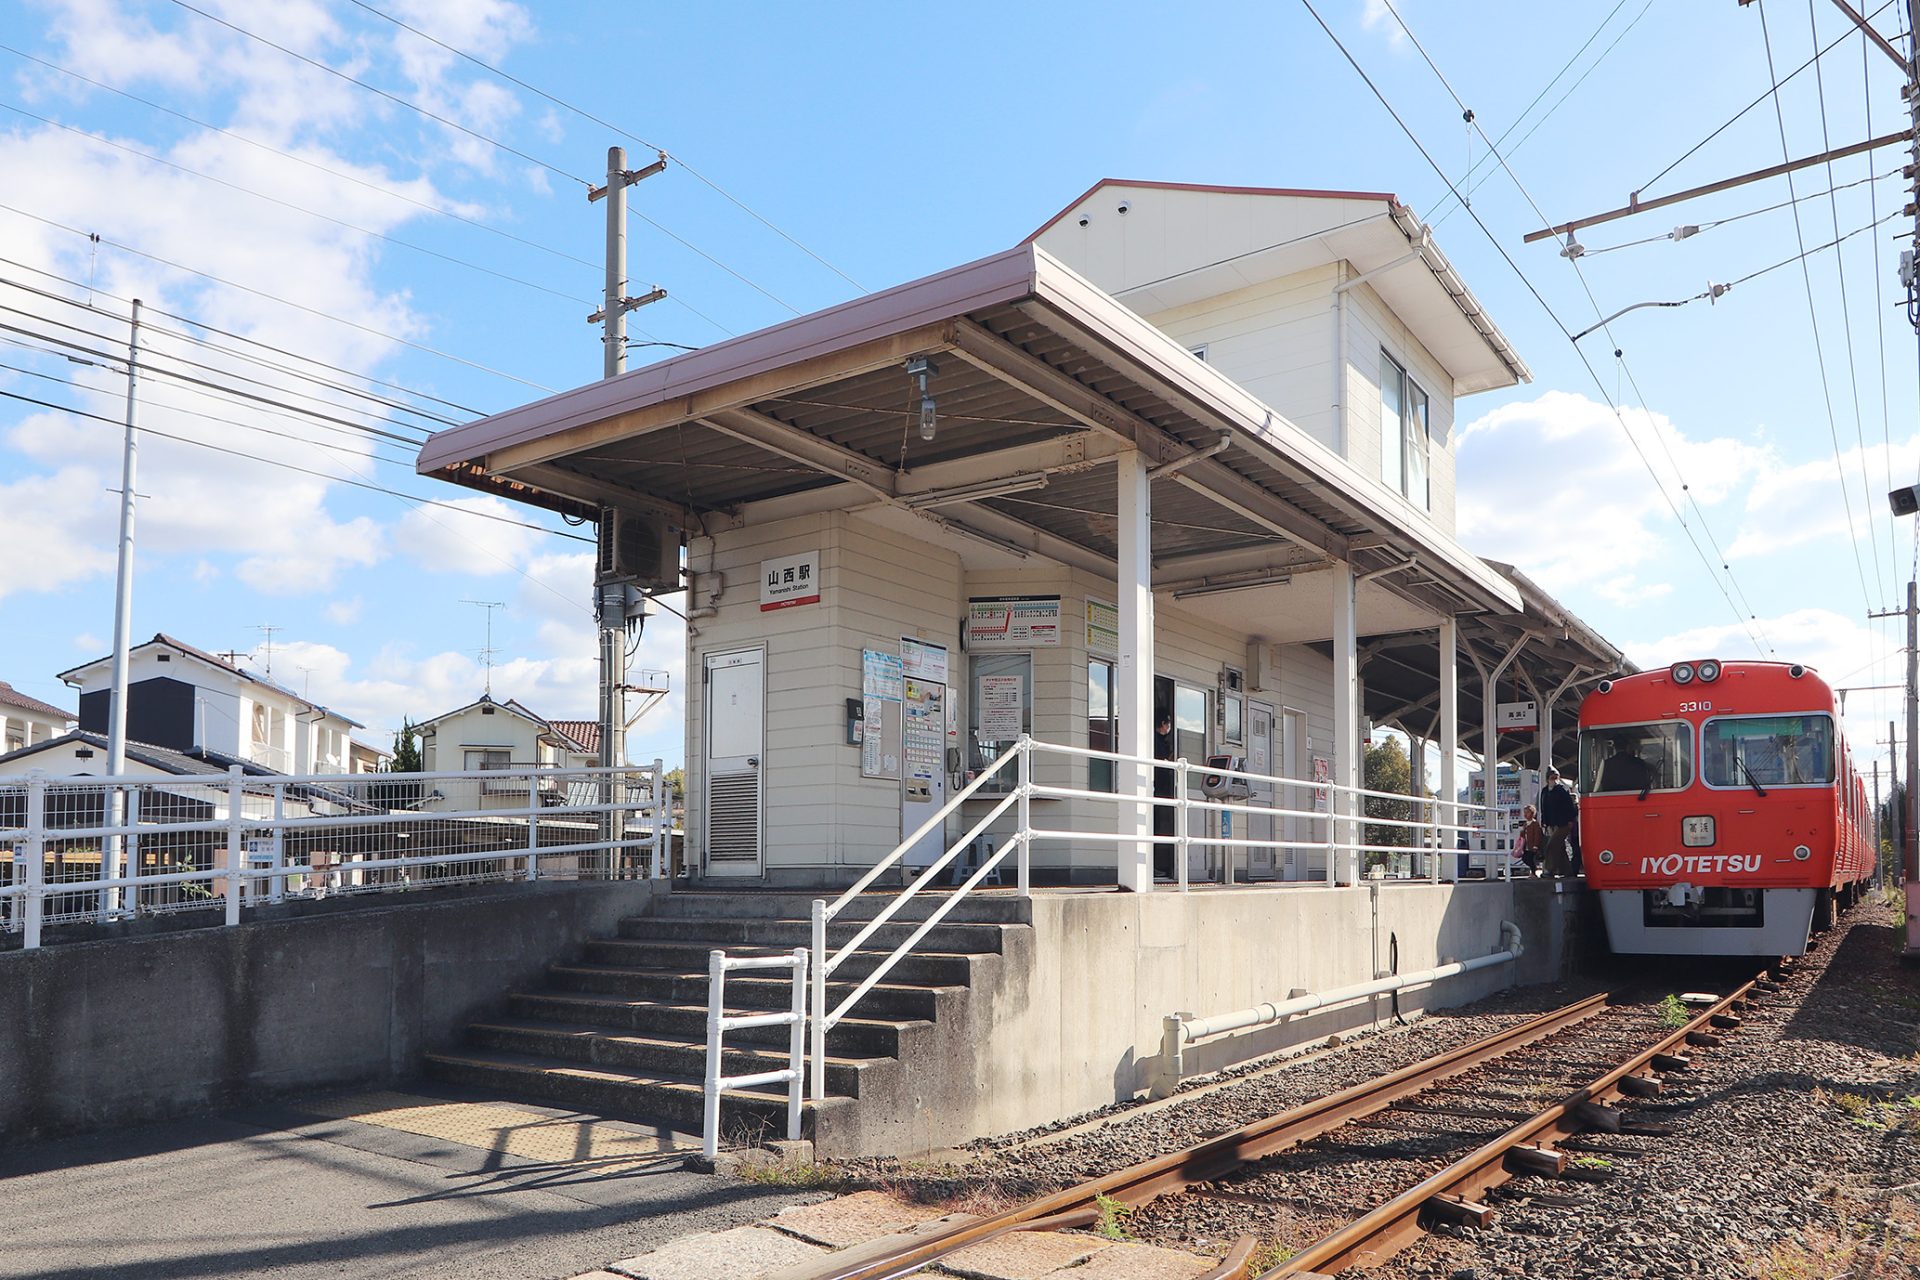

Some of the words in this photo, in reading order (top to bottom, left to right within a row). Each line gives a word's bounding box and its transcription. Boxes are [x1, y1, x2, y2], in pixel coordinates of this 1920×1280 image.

[768, 564, 810, 587] 山西駅
[792, 584, 809, 592] Station
[1679, 701, 1712, 713] 3310
[1640, 853, 1762, 875] IYOTETSU
